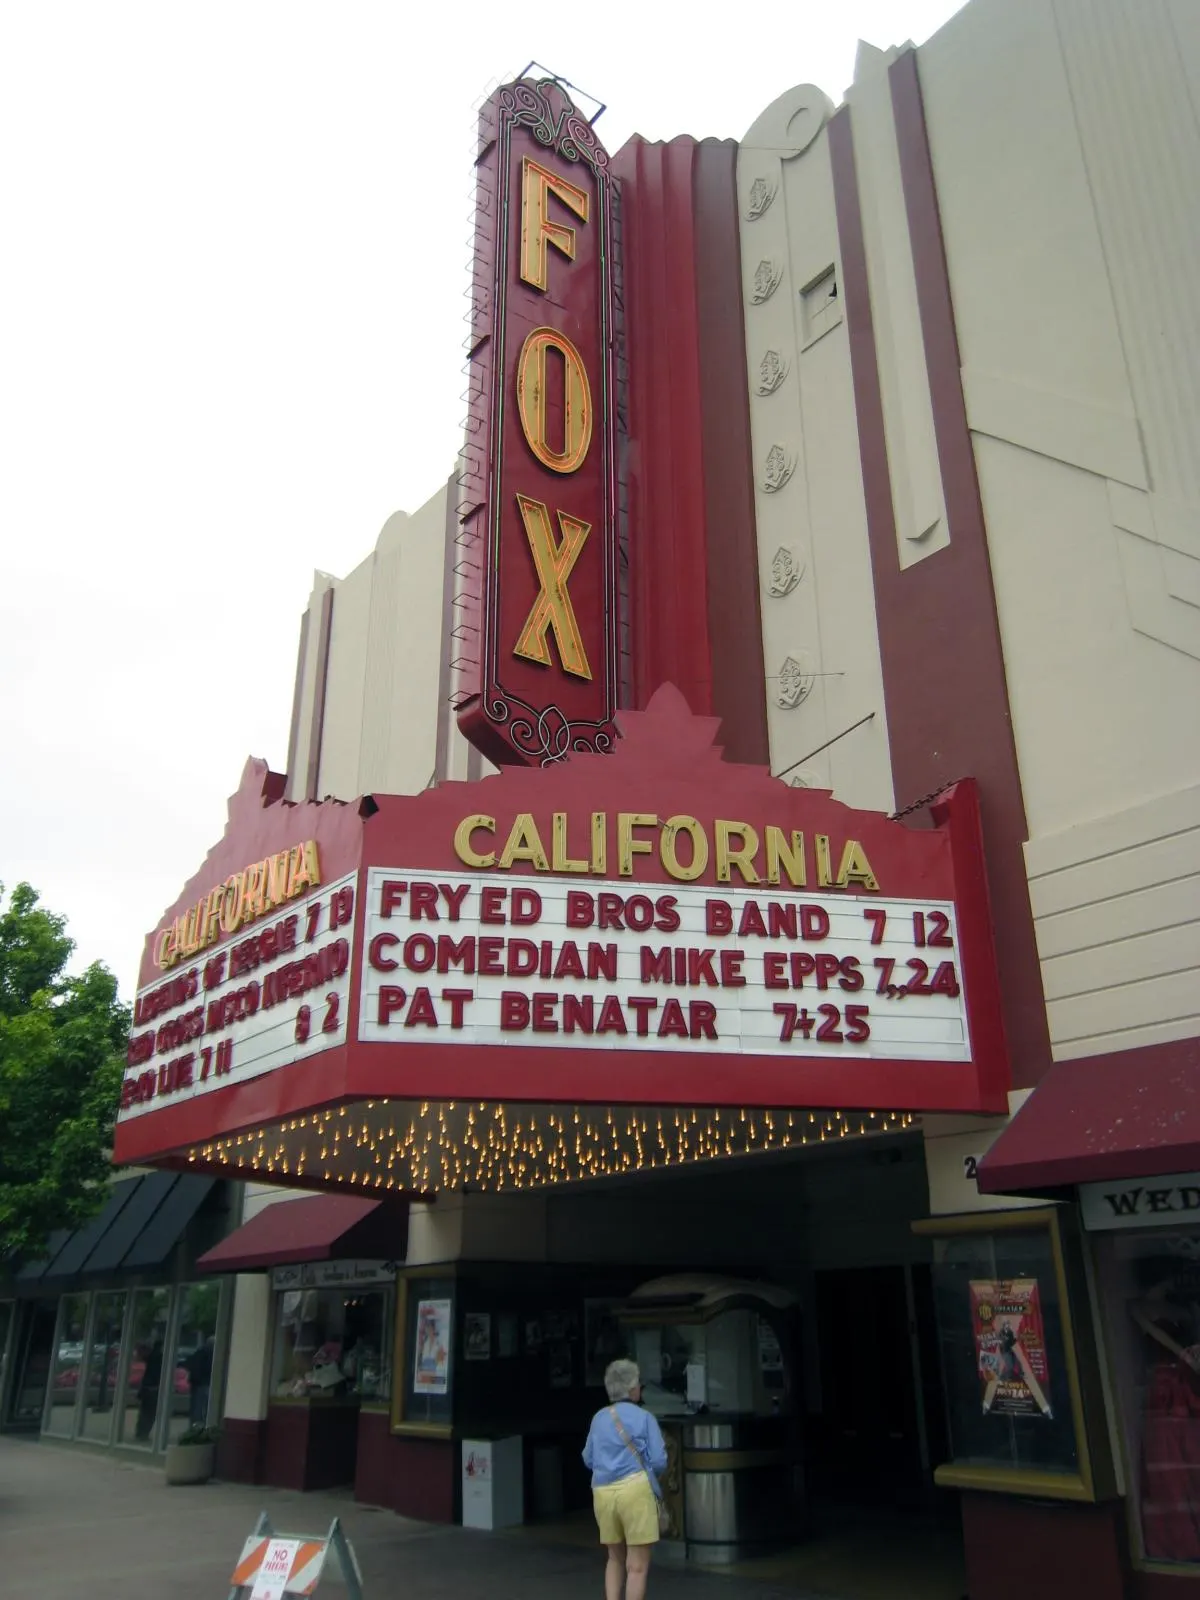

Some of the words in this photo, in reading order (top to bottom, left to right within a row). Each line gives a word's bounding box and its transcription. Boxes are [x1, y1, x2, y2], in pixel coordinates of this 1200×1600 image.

[513, 154, 592, 682] FOX
[453, 812, 880, 891] CALIFORNIA
[153, 839, 320, 971] CALIFORNIA
[380, 880, 542, 926] FRYED
[566, 891, 681, 932] BROS
[705, 899, 830, 941] BAND
[864, 909, 887, 945] 7
[912, 911, 954, 948] 12
[369, 932, 618, 981] COMEDIAN
[640, 946, 747, 988] MIKE
[763, 952, 865, 993] EPPS
[377, 985, 473, 1030] PAT
[500, 992, 718, 1040] BENATAR
[272, 1549, 288, 1561] NO
